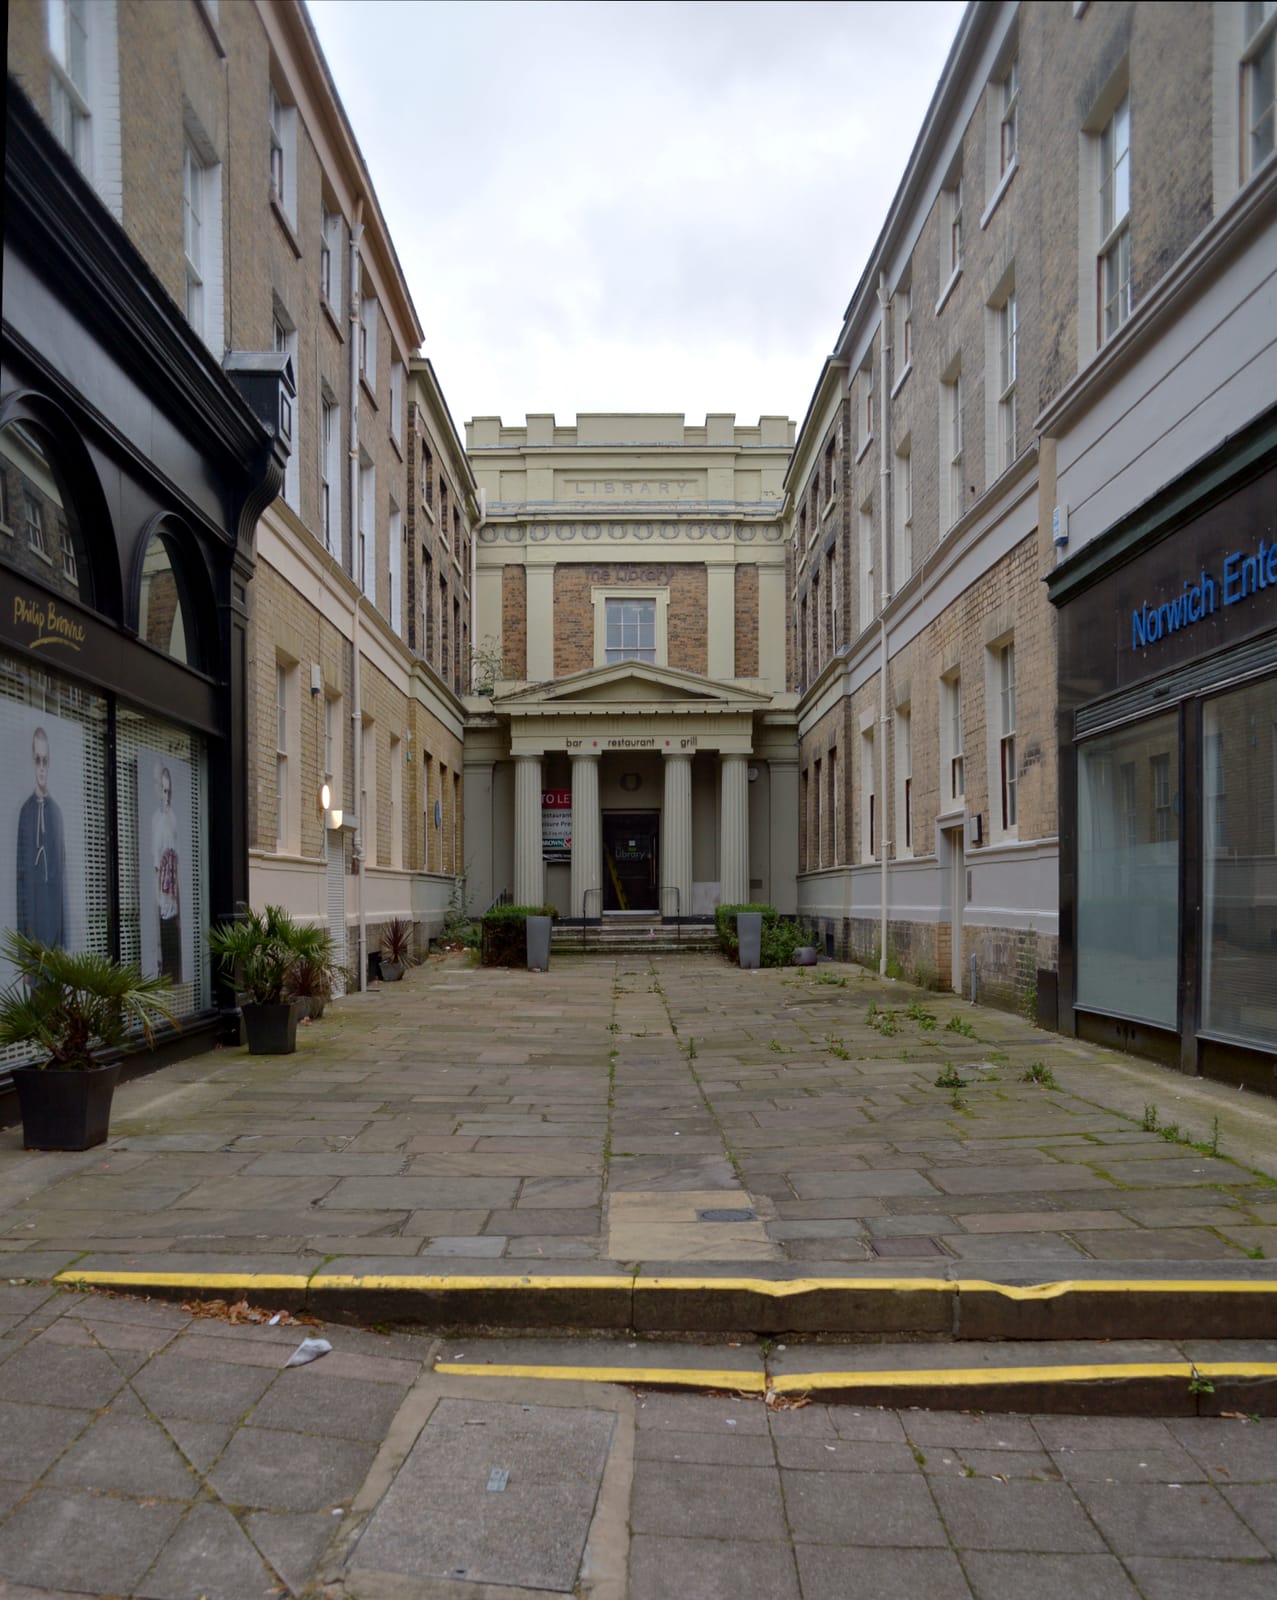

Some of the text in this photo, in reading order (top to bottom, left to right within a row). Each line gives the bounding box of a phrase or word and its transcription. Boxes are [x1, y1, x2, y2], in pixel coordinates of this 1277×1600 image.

[576, 482, 688, 494] LIBRARY
[614, 562, 674, 586] Library
[14, 595, 87, 641] Philip Browne
[1132, 571, 1215, 650] Norwich
[566, 736, 698, 749] bar restaurant grill
[557, 794, 572, 804] LE
